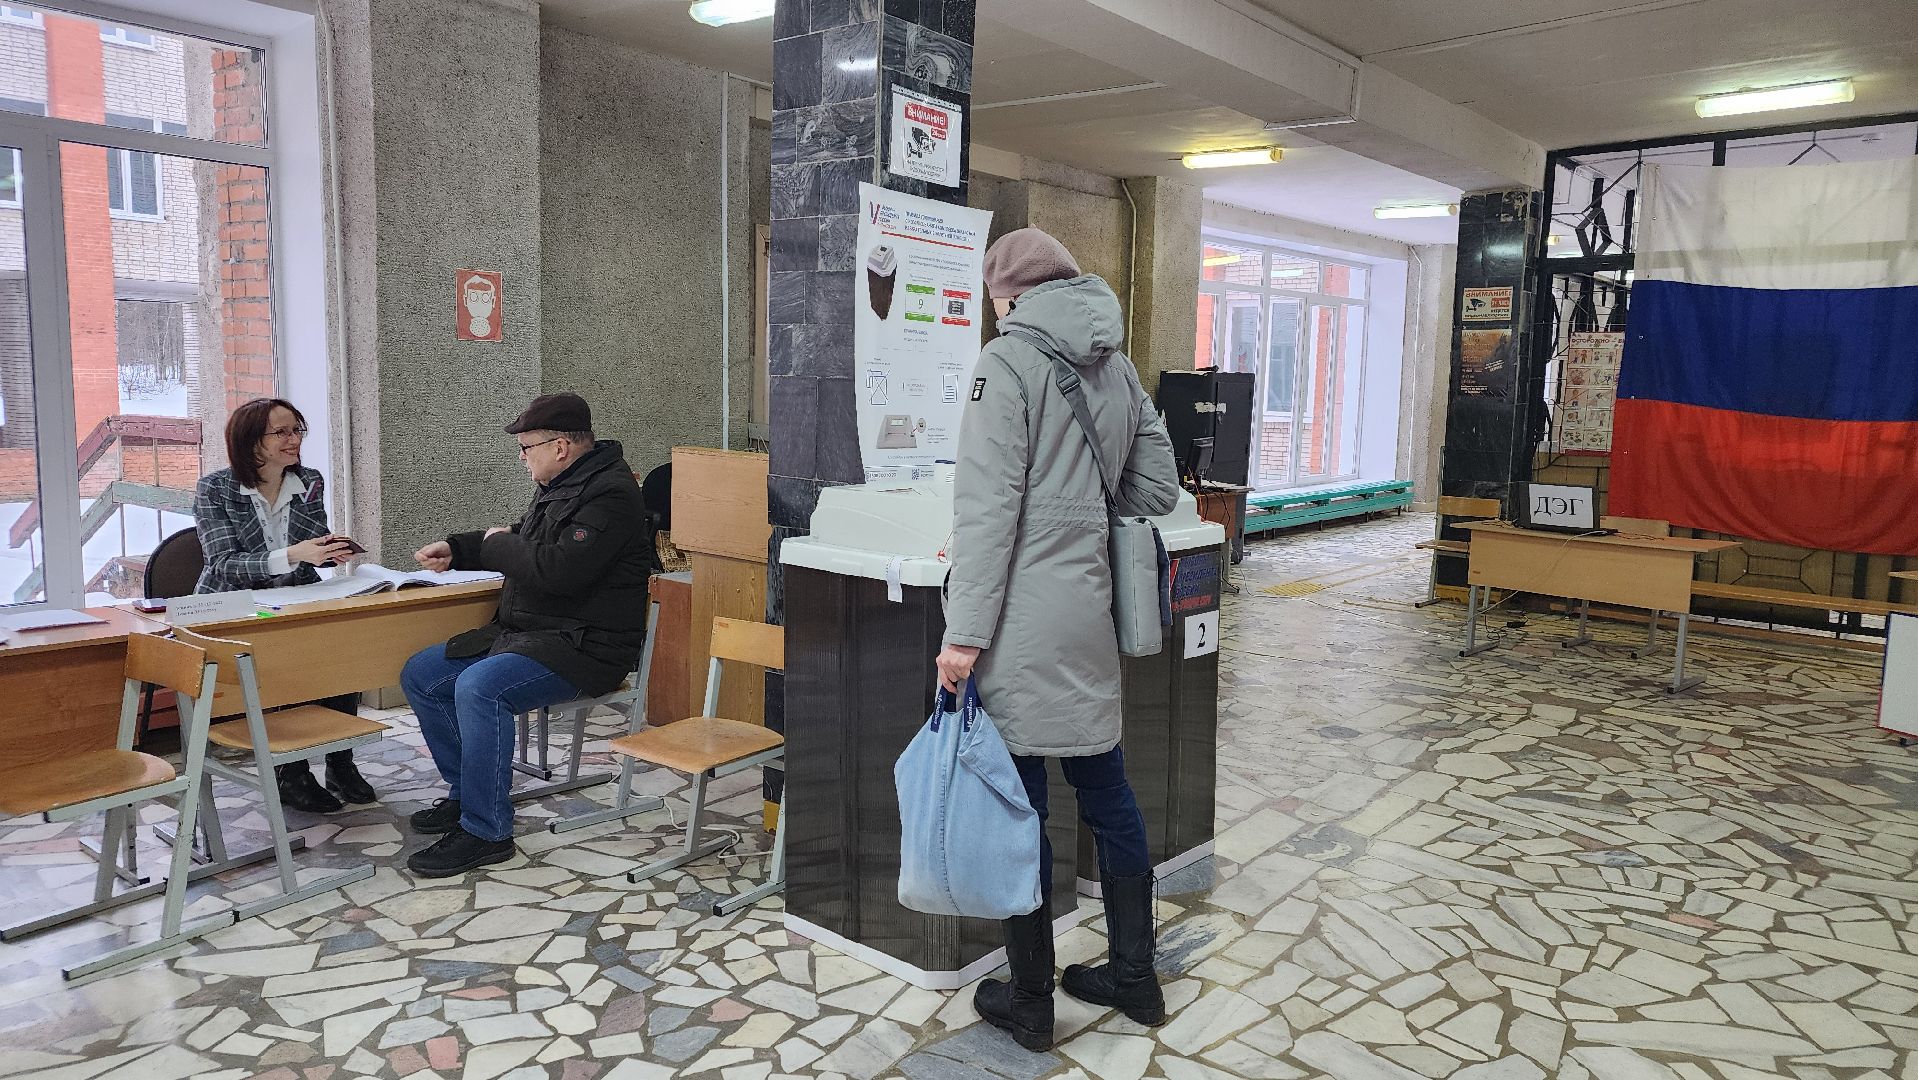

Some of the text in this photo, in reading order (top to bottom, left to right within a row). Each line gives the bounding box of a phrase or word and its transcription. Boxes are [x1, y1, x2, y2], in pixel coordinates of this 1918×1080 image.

[908, 107, 946, 126] ВНИМАНИЕ!
[1534, 497, 1583, 516] ДЭГ
[1197, 623, 1205, 648] 2
